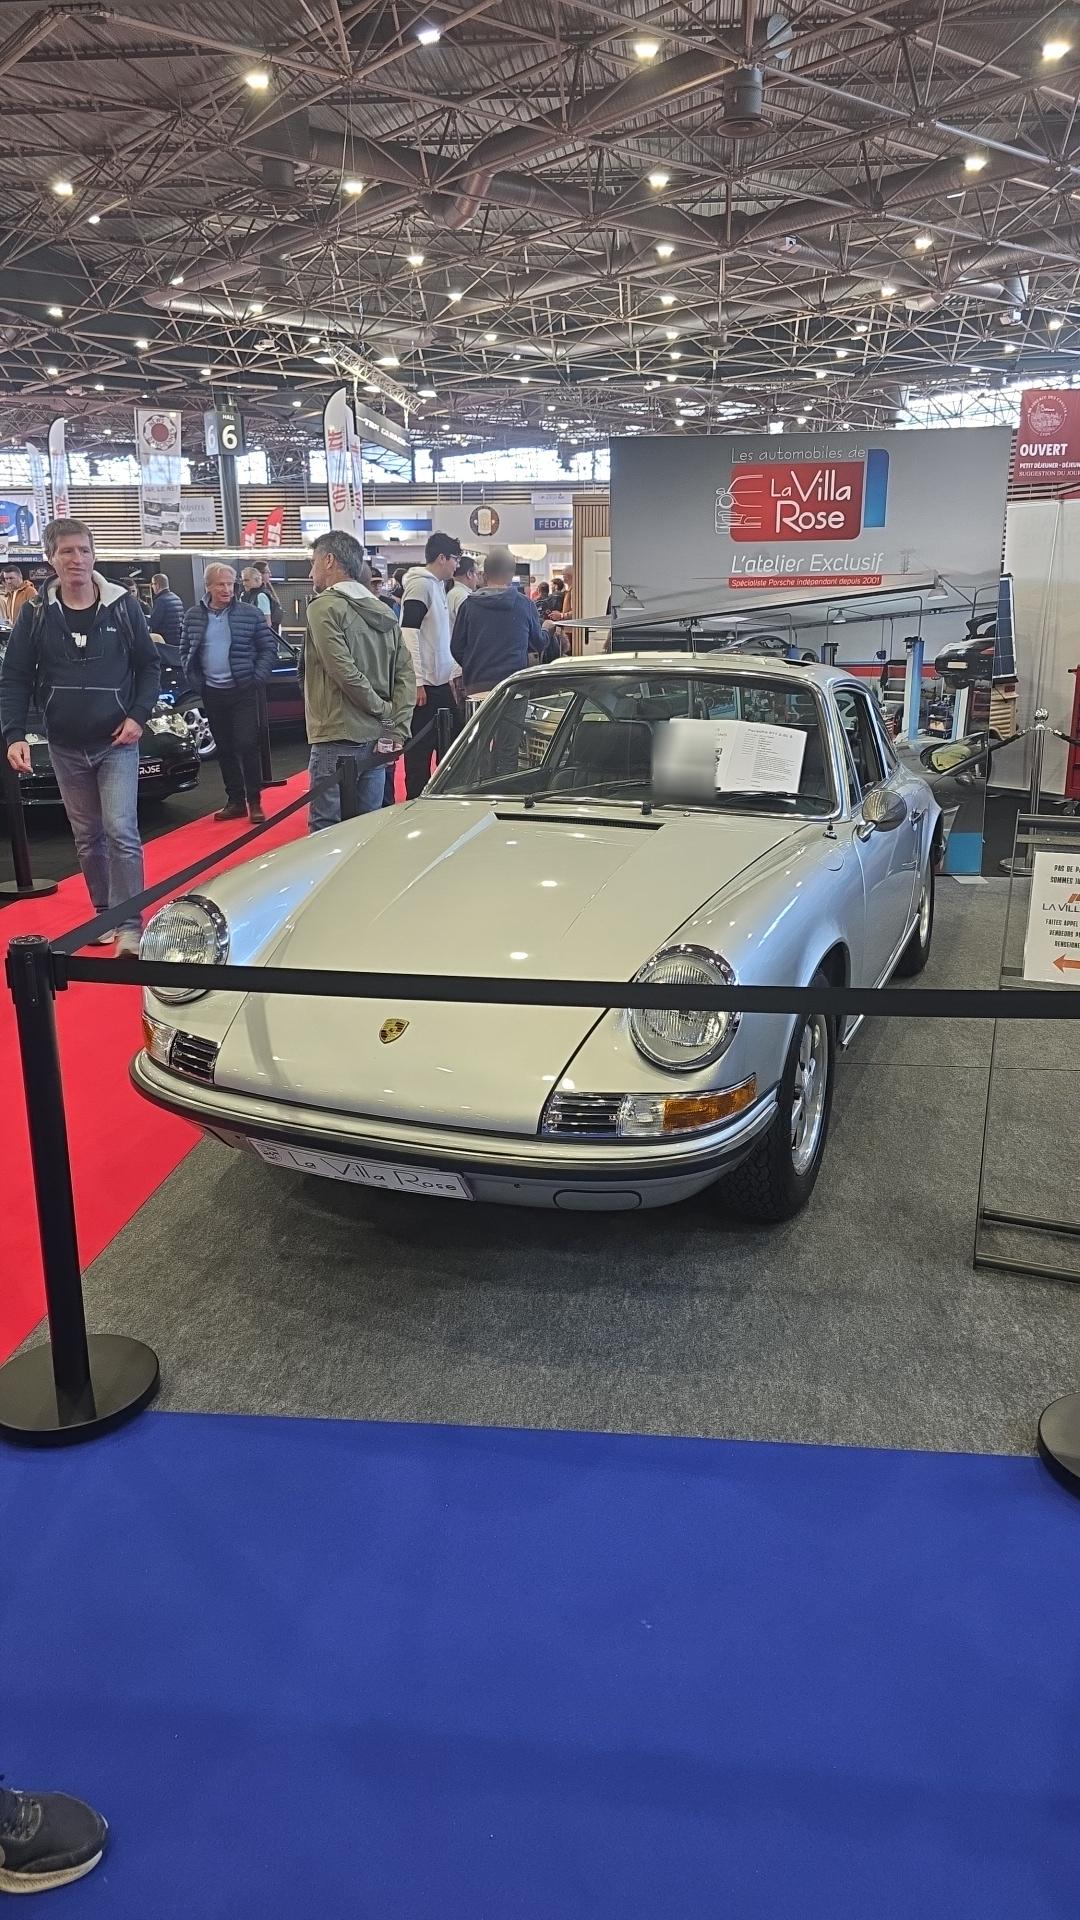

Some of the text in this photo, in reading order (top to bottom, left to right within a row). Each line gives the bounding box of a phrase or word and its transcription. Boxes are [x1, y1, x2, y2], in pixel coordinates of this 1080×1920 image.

[208, 425, 216, 449] 6
[222, 424, 238, 450] 6
[731, 445, 866, 464] Les automobiles de
[1020, 443, 1068, 457] OUVERT
[771, 469, 852, 502] La Villa
[775, 500, 845, 534] Rose
[731, 553, 884, 574] L'atelier Exclusif
[731, 576, 880, 588] Spécialiste Porsche indépendant depuis 2001
[1050, 876, 1073, 884] SOMMES
[1042, 903, 1056, 911] LA
[288, 1151, 316, 1169] La
[320, 1157, 386, 1182] Villa
[393, 1170, 457, 1191] Rose
